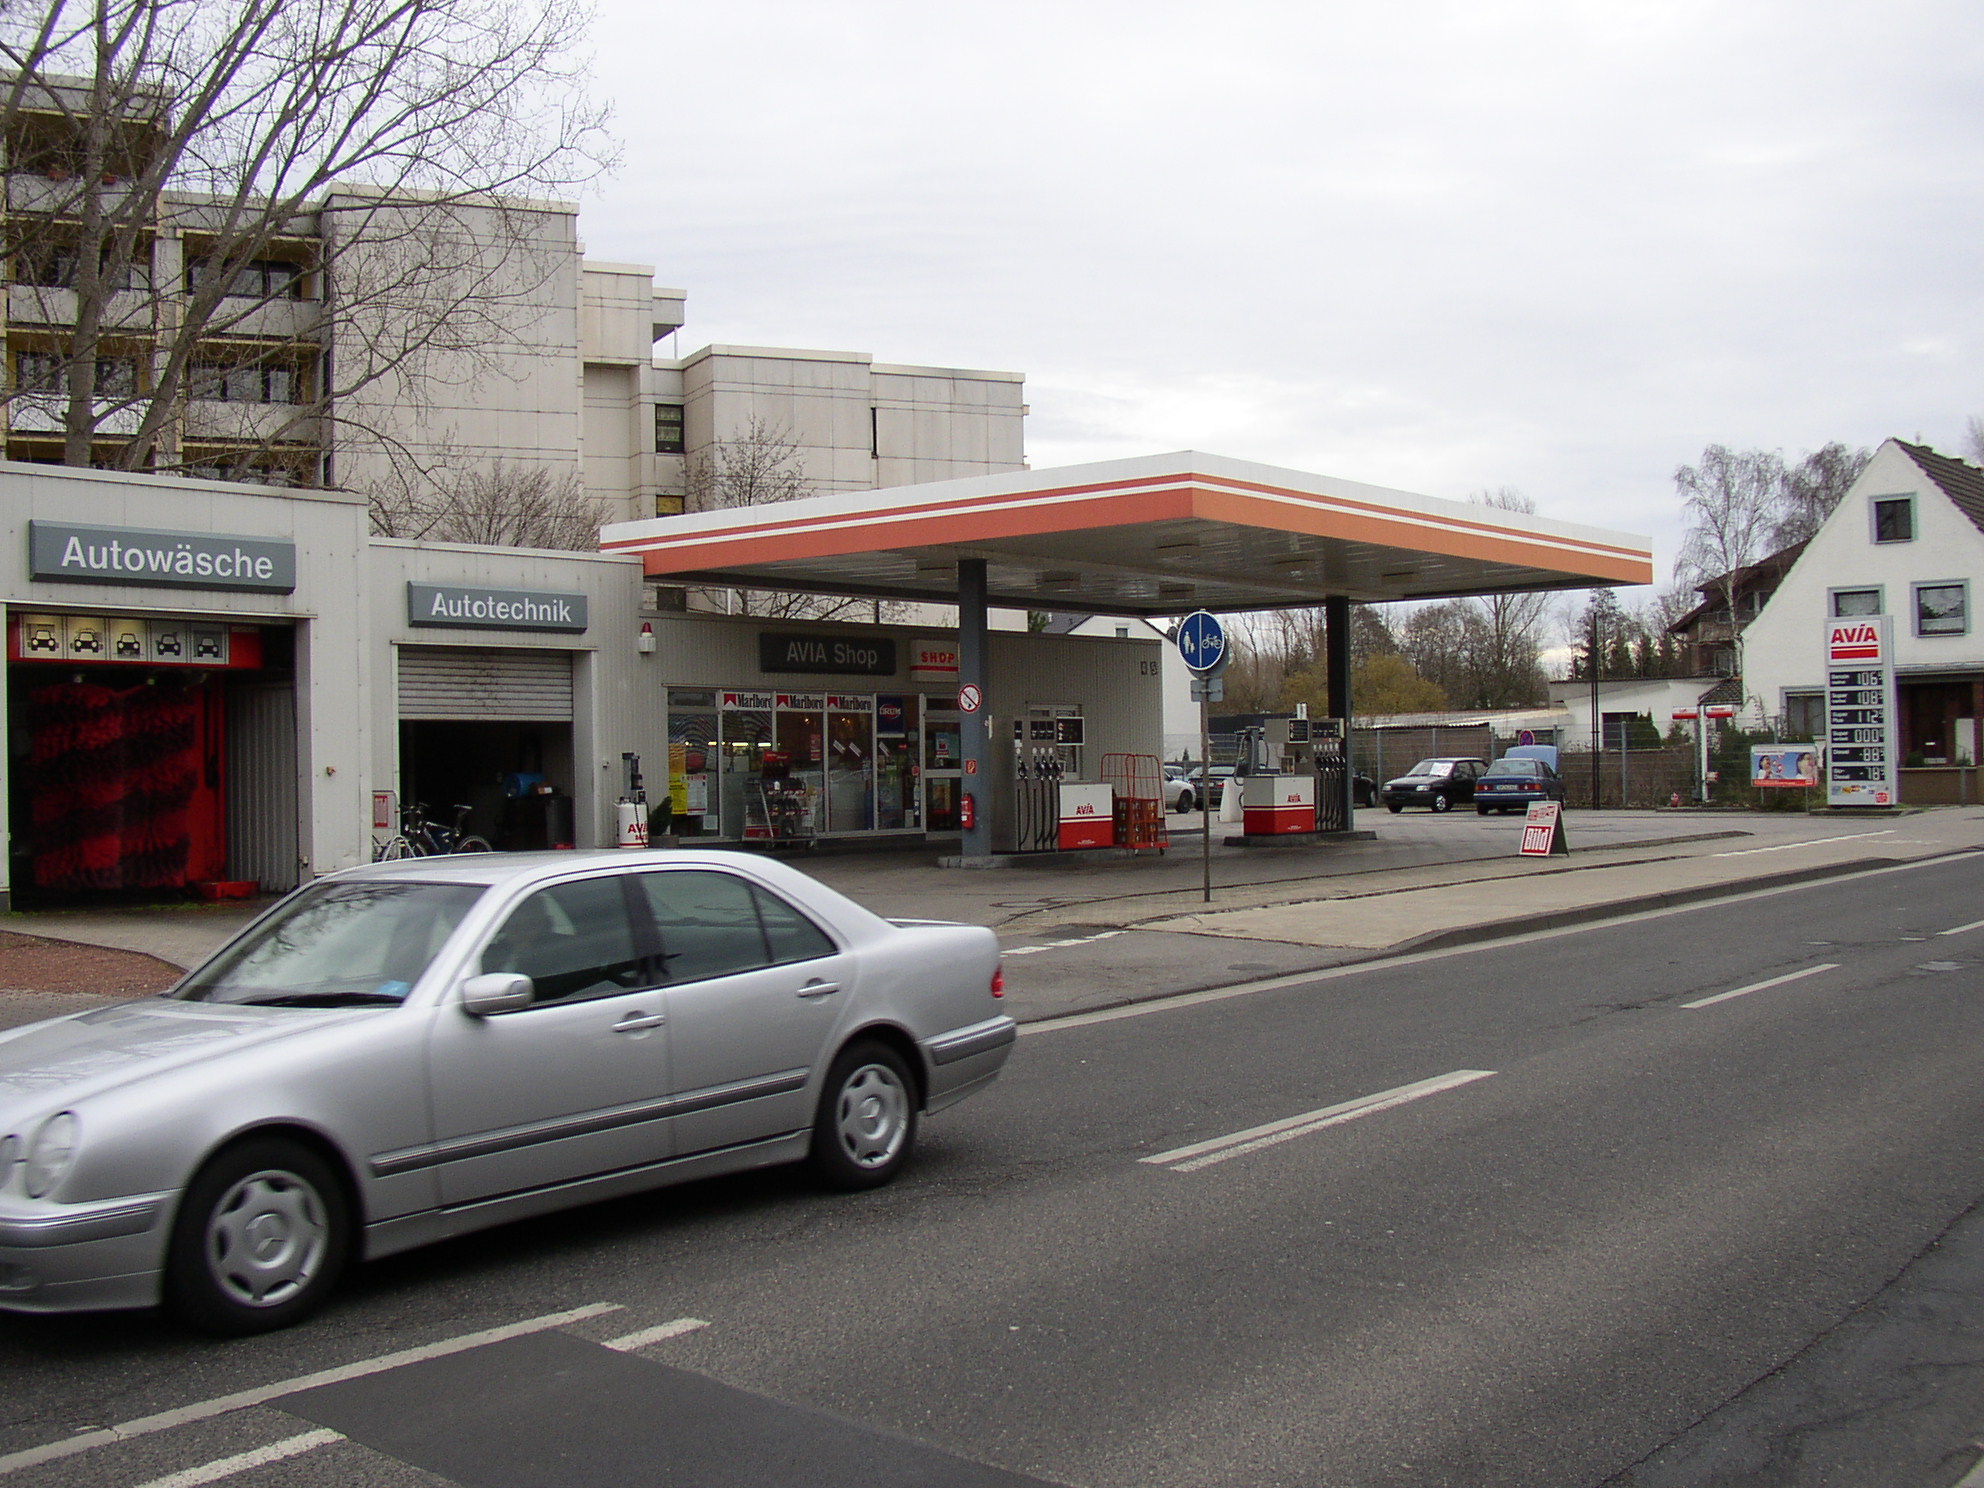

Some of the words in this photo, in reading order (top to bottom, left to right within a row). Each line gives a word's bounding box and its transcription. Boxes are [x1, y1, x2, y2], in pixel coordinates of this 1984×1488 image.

[61, 535, 273, 580] Autowäsche
[431, 592, 572, 623] Autotechnik
[1831, 624, 1878, 643] AVIA
[786, 641, 828, 662] AVIA
[833, 643, 878, 669] Shop
[921, 651, 955, 664] SHOP
[789, 694, 824, 709] Marlboro
[838, 696, 872, 710] Marlboro
